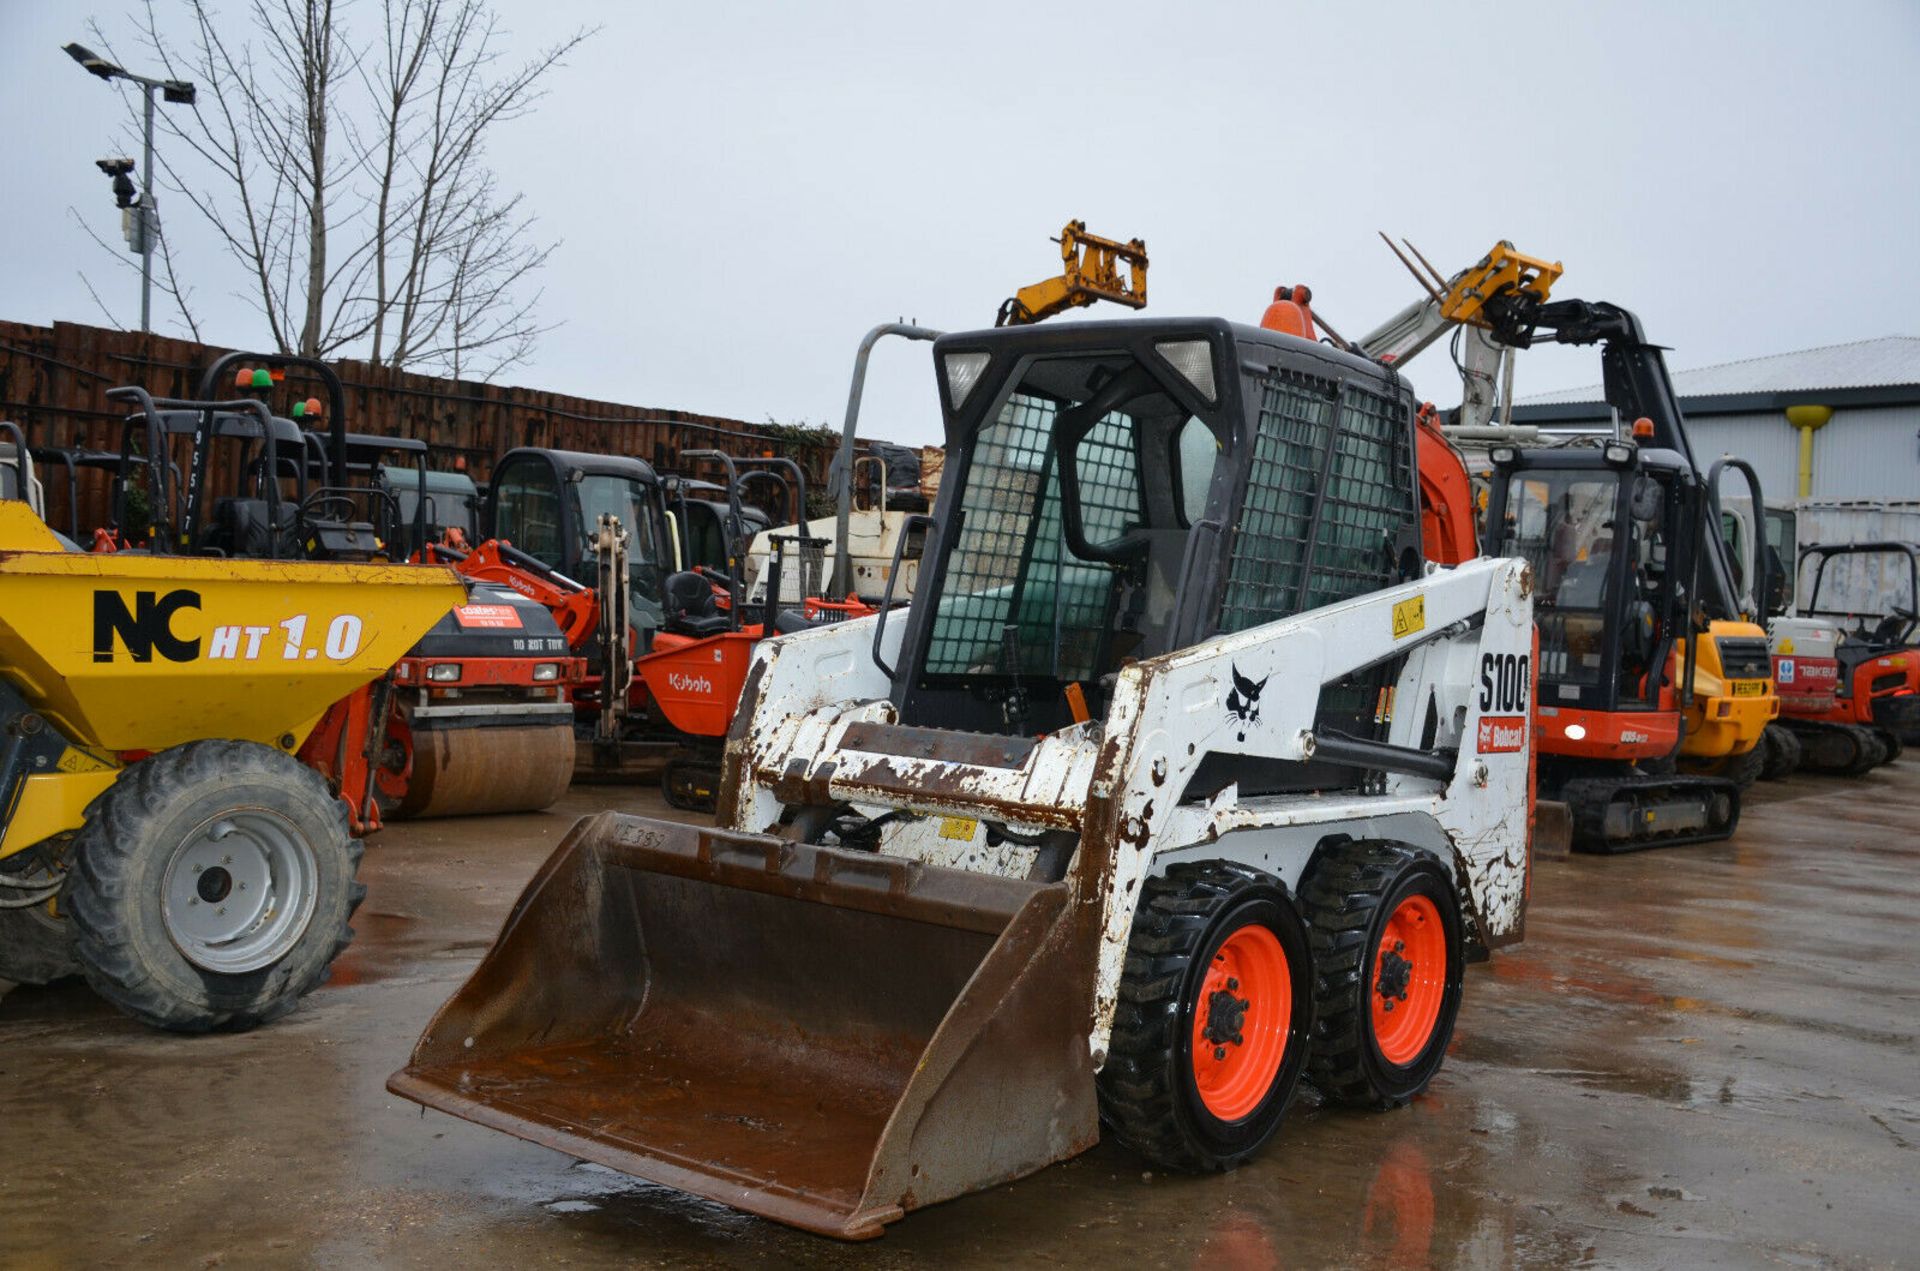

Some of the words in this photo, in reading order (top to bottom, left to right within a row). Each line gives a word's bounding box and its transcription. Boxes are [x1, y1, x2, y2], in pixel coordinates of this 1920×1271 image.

[93, 588, 203, 663] NC
[208, 625, 270, 660] HT
[279, 613, 363, 661] 1.0
[668, 672, 712, 694] Kubota
[1480, 652, 1529, 713] S100
[1493, 725, 1523, 748] Bobcat
